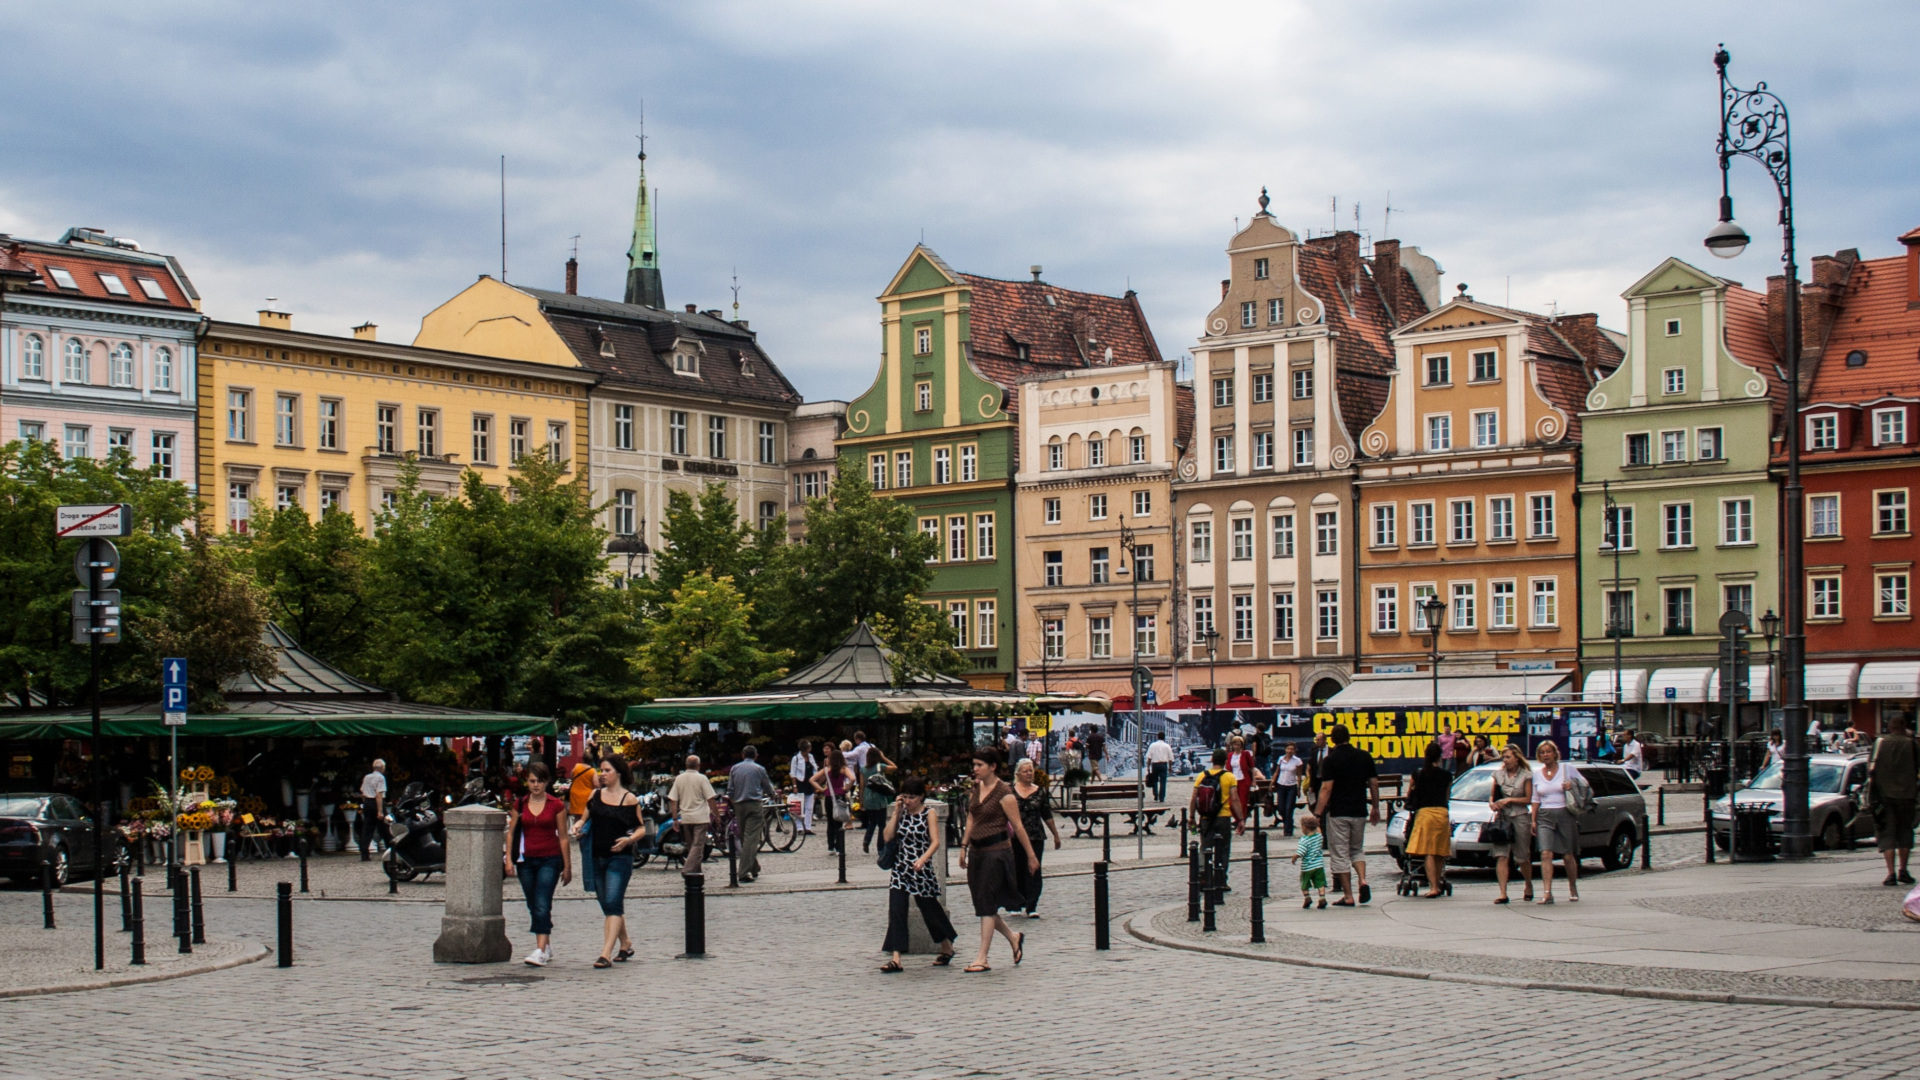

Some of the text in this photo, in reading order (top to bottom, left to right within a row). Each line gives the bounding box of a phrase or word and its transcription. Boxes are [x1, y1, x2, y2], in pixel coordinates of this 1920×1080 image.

[60, 512, 80, 520] Droga
[169, 688, 182, 708] P
[1666, 688, 1674, 696] P
[1313, 712, 1396, 735] CAŁE
[1405, 710, 1520, 734] MORZE
